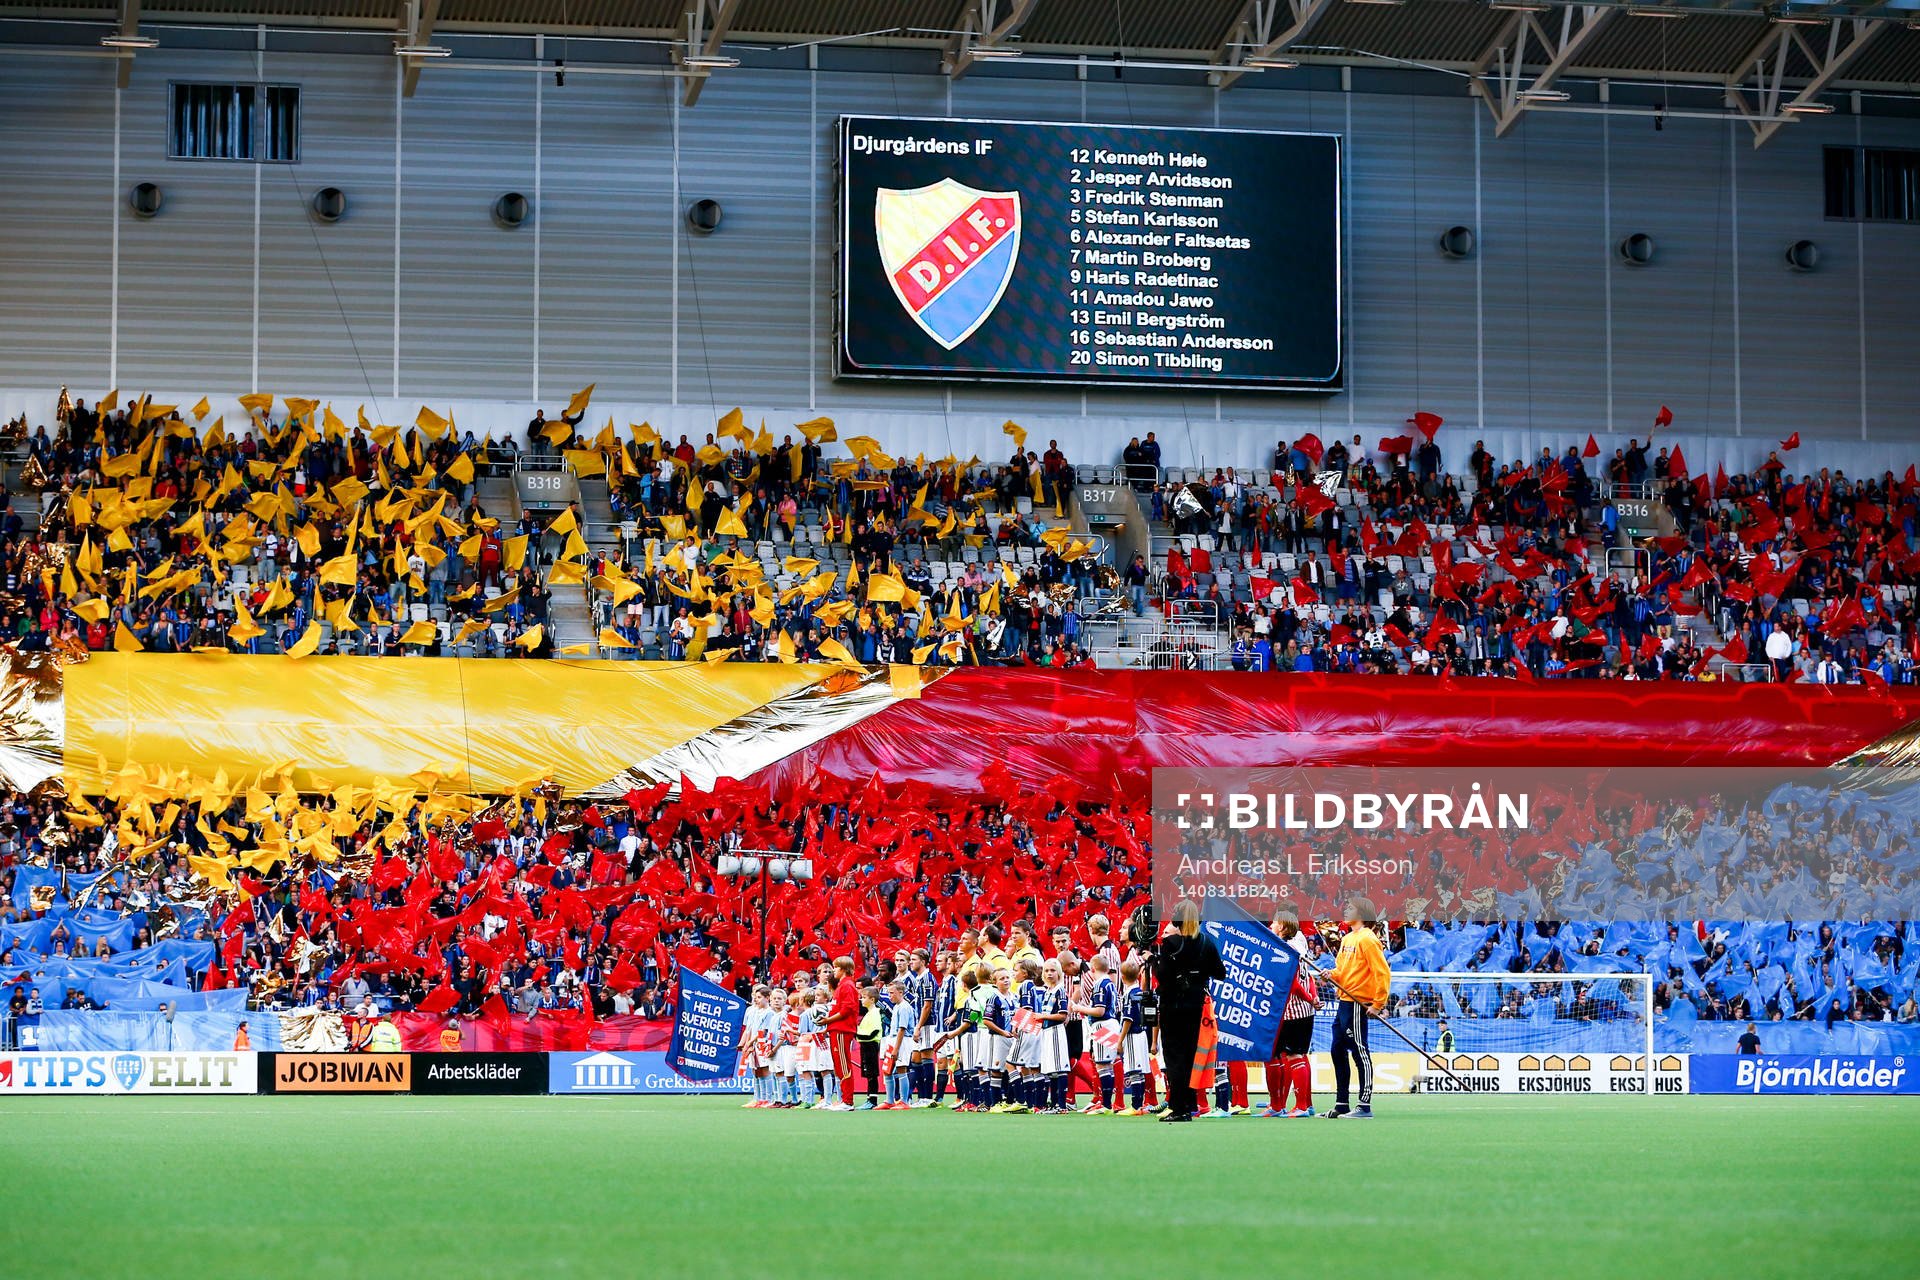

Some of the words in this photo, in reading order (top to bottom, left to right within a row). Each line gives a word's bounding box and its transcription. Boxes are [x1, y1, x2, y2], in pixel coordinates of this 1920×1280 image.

[853, 135, 970, 155] Djurgårdens
[975, 139, 993, 155] IF
[1070, 149, 1090, 163] 12
[1094, 150, 1164, 167] Kenneth
[1169, 153, 1207, 168] Høie
[1070, 169, 1081, 183] 2
[1085, 170, 1143, 187] Jesper
[1146, 172, 1232, 189] Arvidsson
[1070, 189, 1081, 203] 3
[1085, 190, 1145, 206] Fredrik
[1149, 192, 1223, 208] Stenman
[1070, 210, 1081, 223] 5
[1085, 210, 1139, 225] Stefan
[1144, 212, 1219, 228] Karlsson
[1070, 229, 1081, 243] 6
[1085, 230, 1171, 246] Alexander
[1175, 233, 1251, 249] Faltsetas
[1070, 250, 1081, 263] 7
[1085, 250, 1138, 265] Martin
[1143, 252, 1211, 270] Broberg
[1070, 270, 1081, 284] 9
[1086, 270, 1130, 285] Haris
[1135, 272, 1219, 288] Radetinac
[1070, 290, 1088, 304] 11
[1094, 291, 1165, 306] Amadou
[1169, 293, 1214, 308] Jawo
[1070, 310, 1090, 324] 13
[1094, 311, 1131, 326] Emil
[1137, 312, 1225, 330] Bergström
[1070, 330, 1090, 344] 16
[1094, 331, 1177, 347] Sebastian
[1182, 334, 1274, 350] Andersson
[1070, 350, 1091, 365] 20
[1095, 351, 1149, 366] Simon
[1154, 353, 1223, 371] Tibbling
[527, 476, 561, 489] B318
[1083, 489, 1116, 502] B317
[1617, 504, 1648, 517] B316
[1225, 925, 1260, 945] VÄLKOMMEN
[1222, 940, 1262, 970] HELA
[1223, 960, 1274, 996] ERIGES
[1209, 977, 1270, 1016] TBOLLS
[694, 1001, 722, 1017] HELA
[1213, 1001, 1253, 1028] LUBB
[681, 1012, 731, 1033] SVERIGES
[679, 1024, 730, 1047] FOTBOLLS
[684, 1040, 717, 1058] KLUBB
[18, 1056, 105, 1087] TIPS
[150, 1057, 238, 1087] ELIT
[281, 1061, 403, 1082] JOBMAN
[428, 1063, 521, 1080] Arbetskläder
[1736, 1060, 1905, 1093] Björnkläder
[1427, 1074, 1499, 1092] EKSJÖHUS
[1518, 1074, 1591, 1092] EKSJÖHUS
[1610, 1077, 1682, 1092] EKSJHUS
